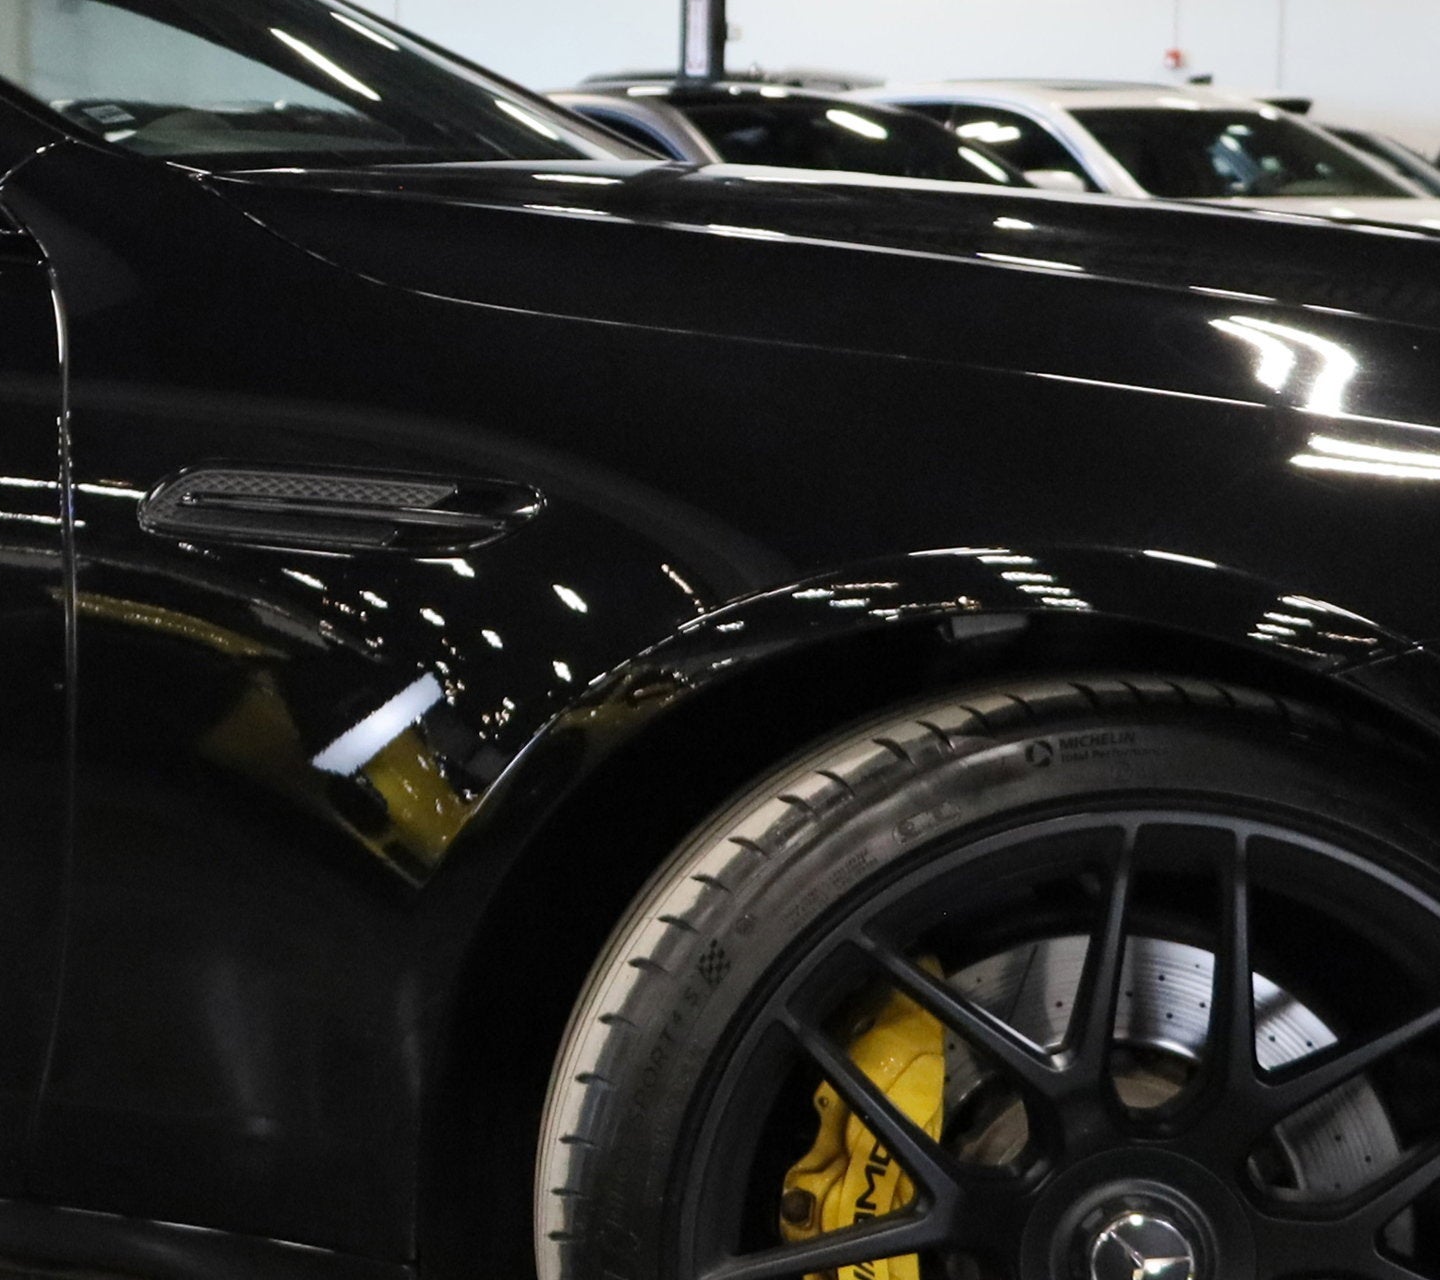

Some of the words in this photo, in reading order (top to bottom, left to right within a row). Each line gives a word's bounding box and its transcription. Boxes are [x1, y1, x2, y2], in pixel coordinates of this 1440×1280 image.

[1059, 730, 1135, 748] MICHELIN
[628, 1023, 677, 1127] SPORT
[683, 985, 701, 1008] S
